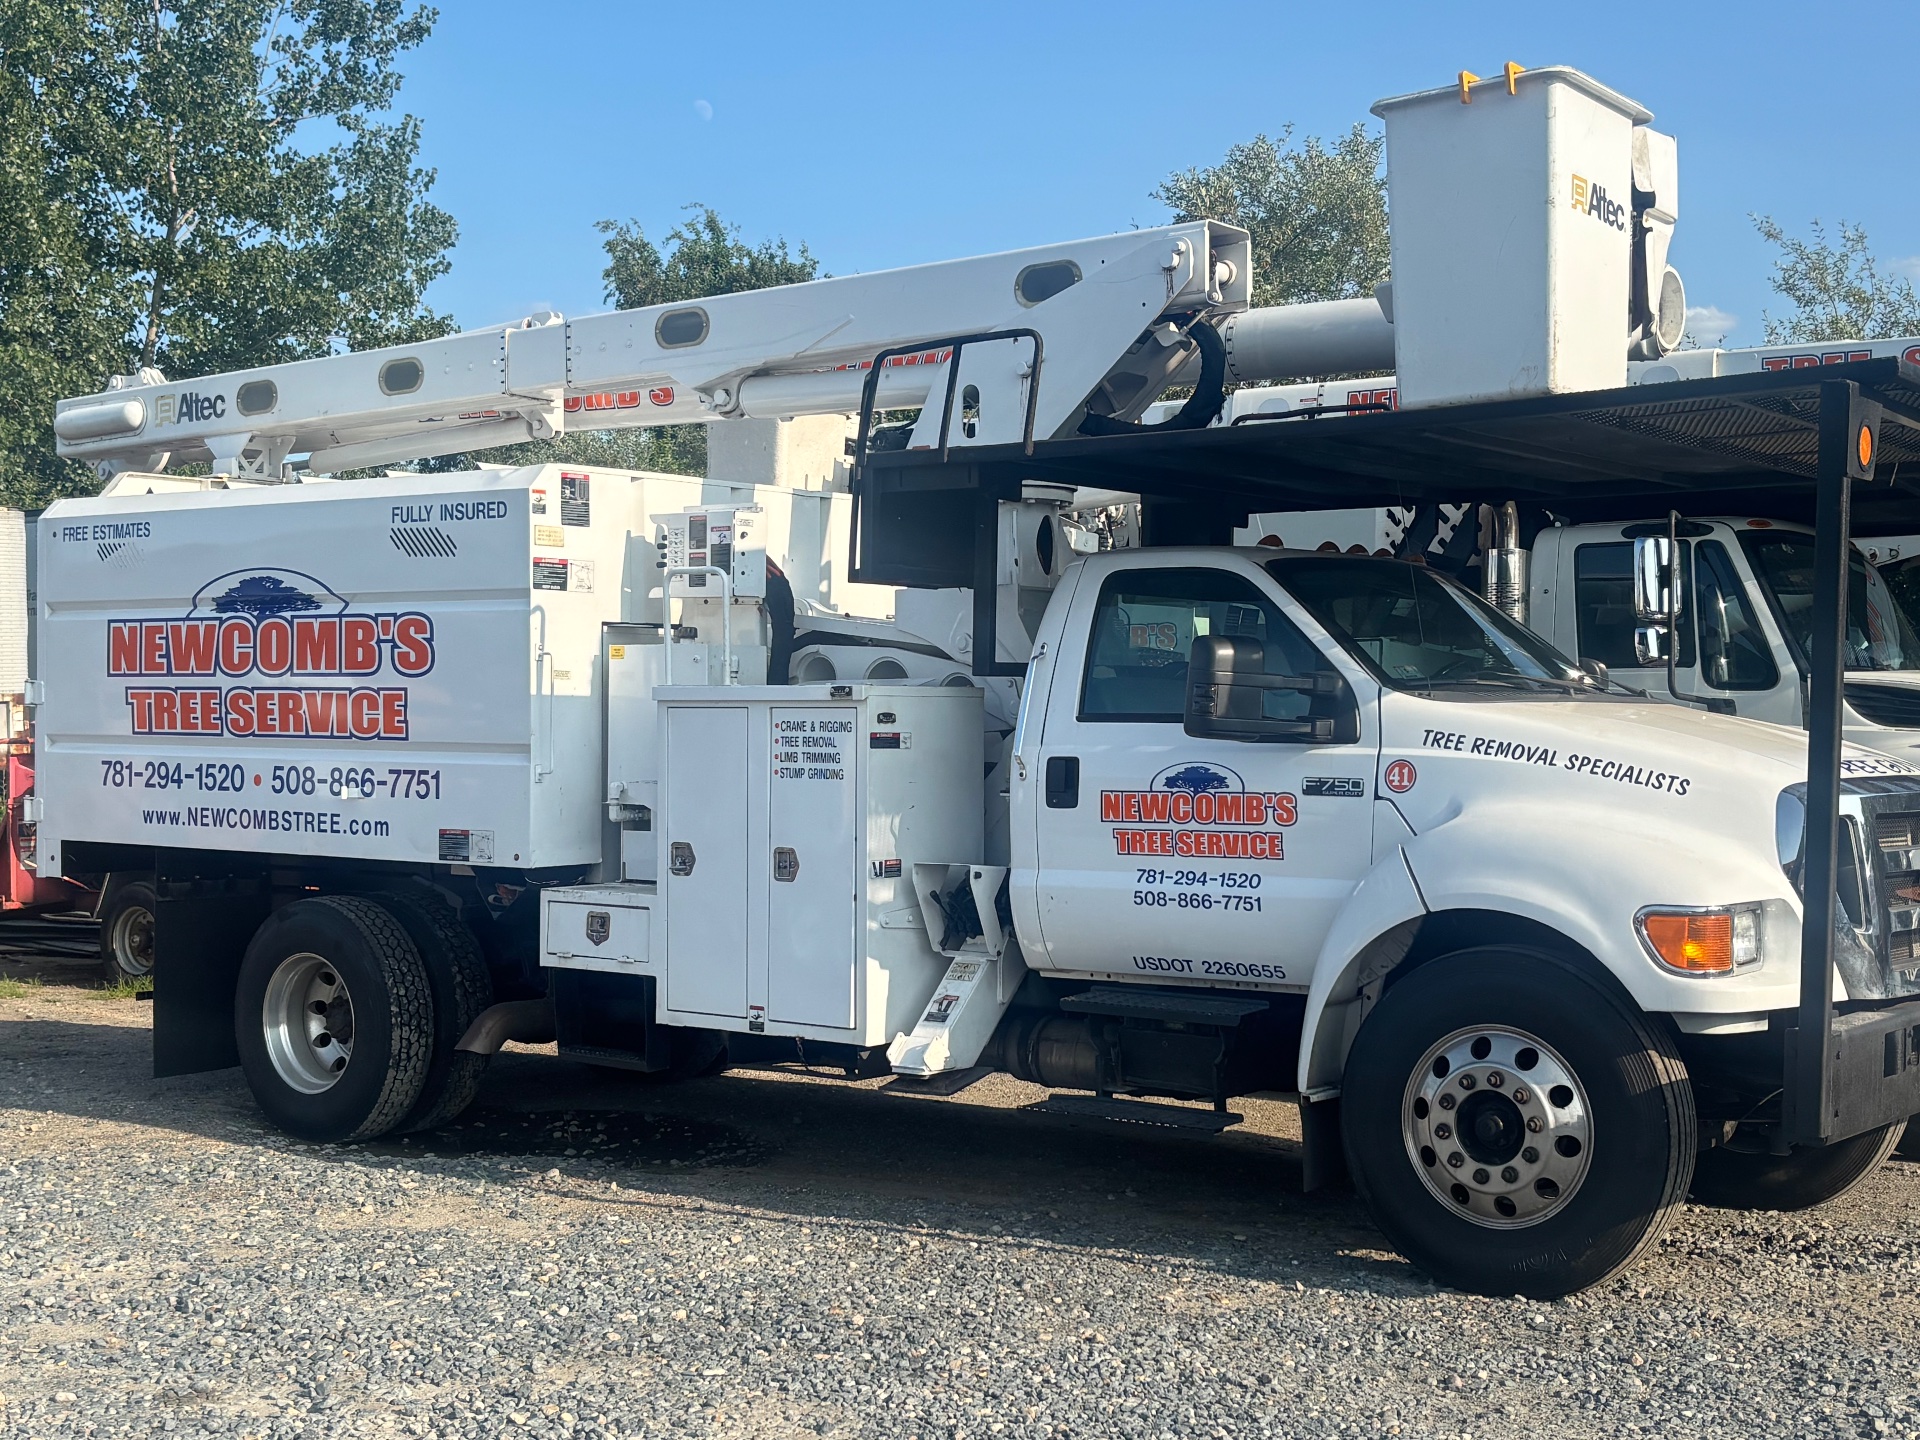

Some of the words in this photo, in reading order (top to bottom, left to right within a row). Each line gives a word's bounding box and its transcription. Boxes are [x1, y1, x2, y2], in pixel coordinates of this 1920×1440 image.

[1587, 182, 1625, 231] Altec
[176, 391, 227, 425] Altec
[391, 504, 435, 524] FULLY
[439, 501, 508, 522] INSURED
[62, 525, 89, 542] FREE
[92, 521, 151, 542] ESTIMATES
[107, 611, 435, 678] NEWCOMB'S
[125, 686, 223, 737] TREE
[223, 686, 409, 741] SERVICE
[780, 720, 807, 732] CRANE
[810, 721, 816, 732] &
[819, 721, 853, 733] RIGGING
[780, 736, 800, 748] TREE
[802, 736, 837, 748] REMOVAL
[780, 752, 799, 763] LIMB
[801, 752, 841, 764] TRIMMING
[1422, 728, 1466, 752] TREE
[1470, 737, 1557, 768] REMOVAL
[1564, 753, 1692, 797] SPECIALISTS
[101, 760, 246, 794] 781-294-1520
[271, 766, 442, 800] 508-866-7751
[780, 767, 806, 779] STUMP
[808, 768, 844, 780] GRINDING
[1389, 766, 1410, 786] 41
[1101, 789, 1298, 827] NEWCOMB'S
[143, 807, 390, 838] www.NEWCOMBSTREE.com
[1112, 828, 1175, 857] TREE
[1175, 829, 1285, 861] SERVICE
[1135, 868, 1262, 890] 781-294-1520
[1133, 890, 1262, 912] 508-866-7751
[1133, 955, 1194, 974] USDOT
[1201, 960, 1287, 980] 2260655
